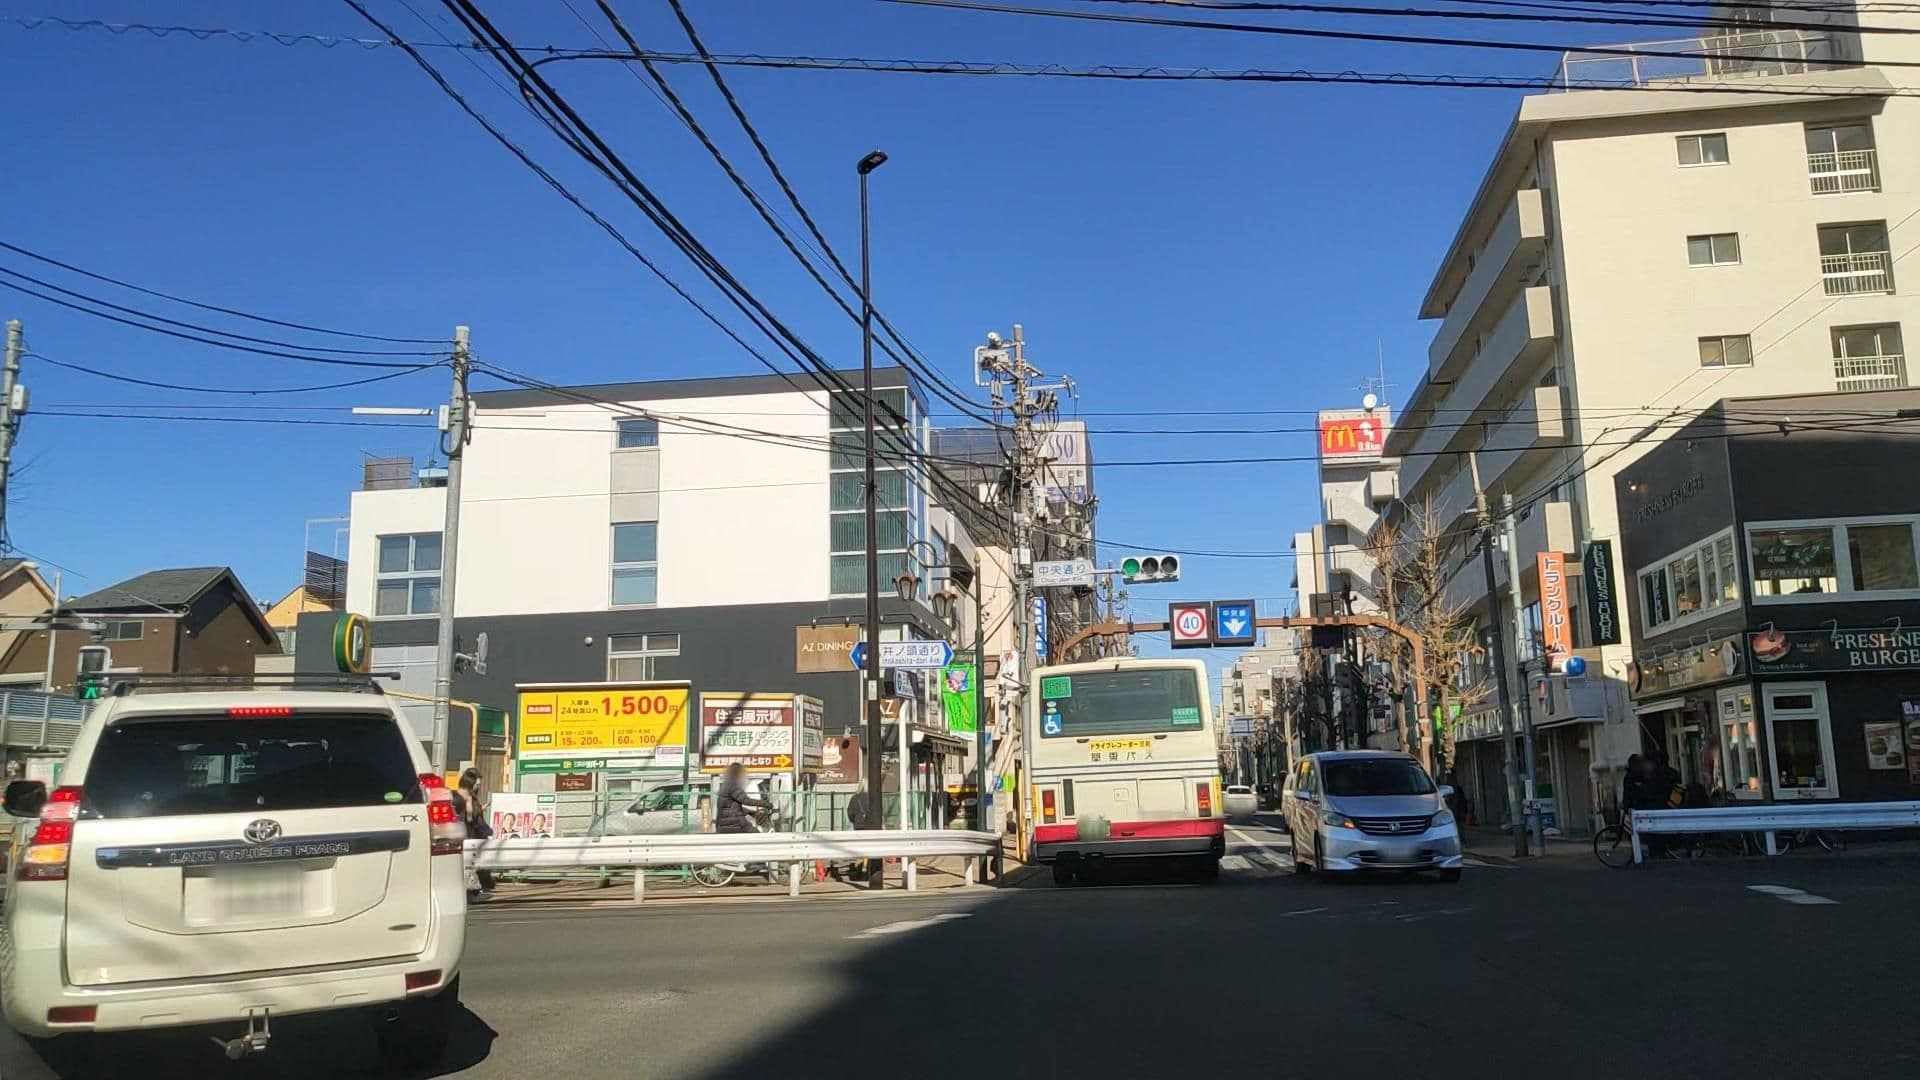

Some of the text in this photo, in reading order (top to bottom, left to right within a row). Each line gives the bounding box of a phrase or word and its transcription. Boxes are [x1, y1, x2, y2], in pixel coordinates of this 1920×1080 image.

[1039, 565, 1086, 576] 中央通り
[1545, 556, 1567, 656] トランクルーム
[1183, 616, 1200, 629] 40
[352, 625, 364, 661] P
[802, 641, 853, 652] AZ DINING
[883, 644, 941, 656] 井ノ頭通り
[707, 730, 753, 747] 武蔵野
[400, 814, 419, 823] TX
[170, 851, 216, 864] LAND
[295, 842, 350, 856] PRADO
